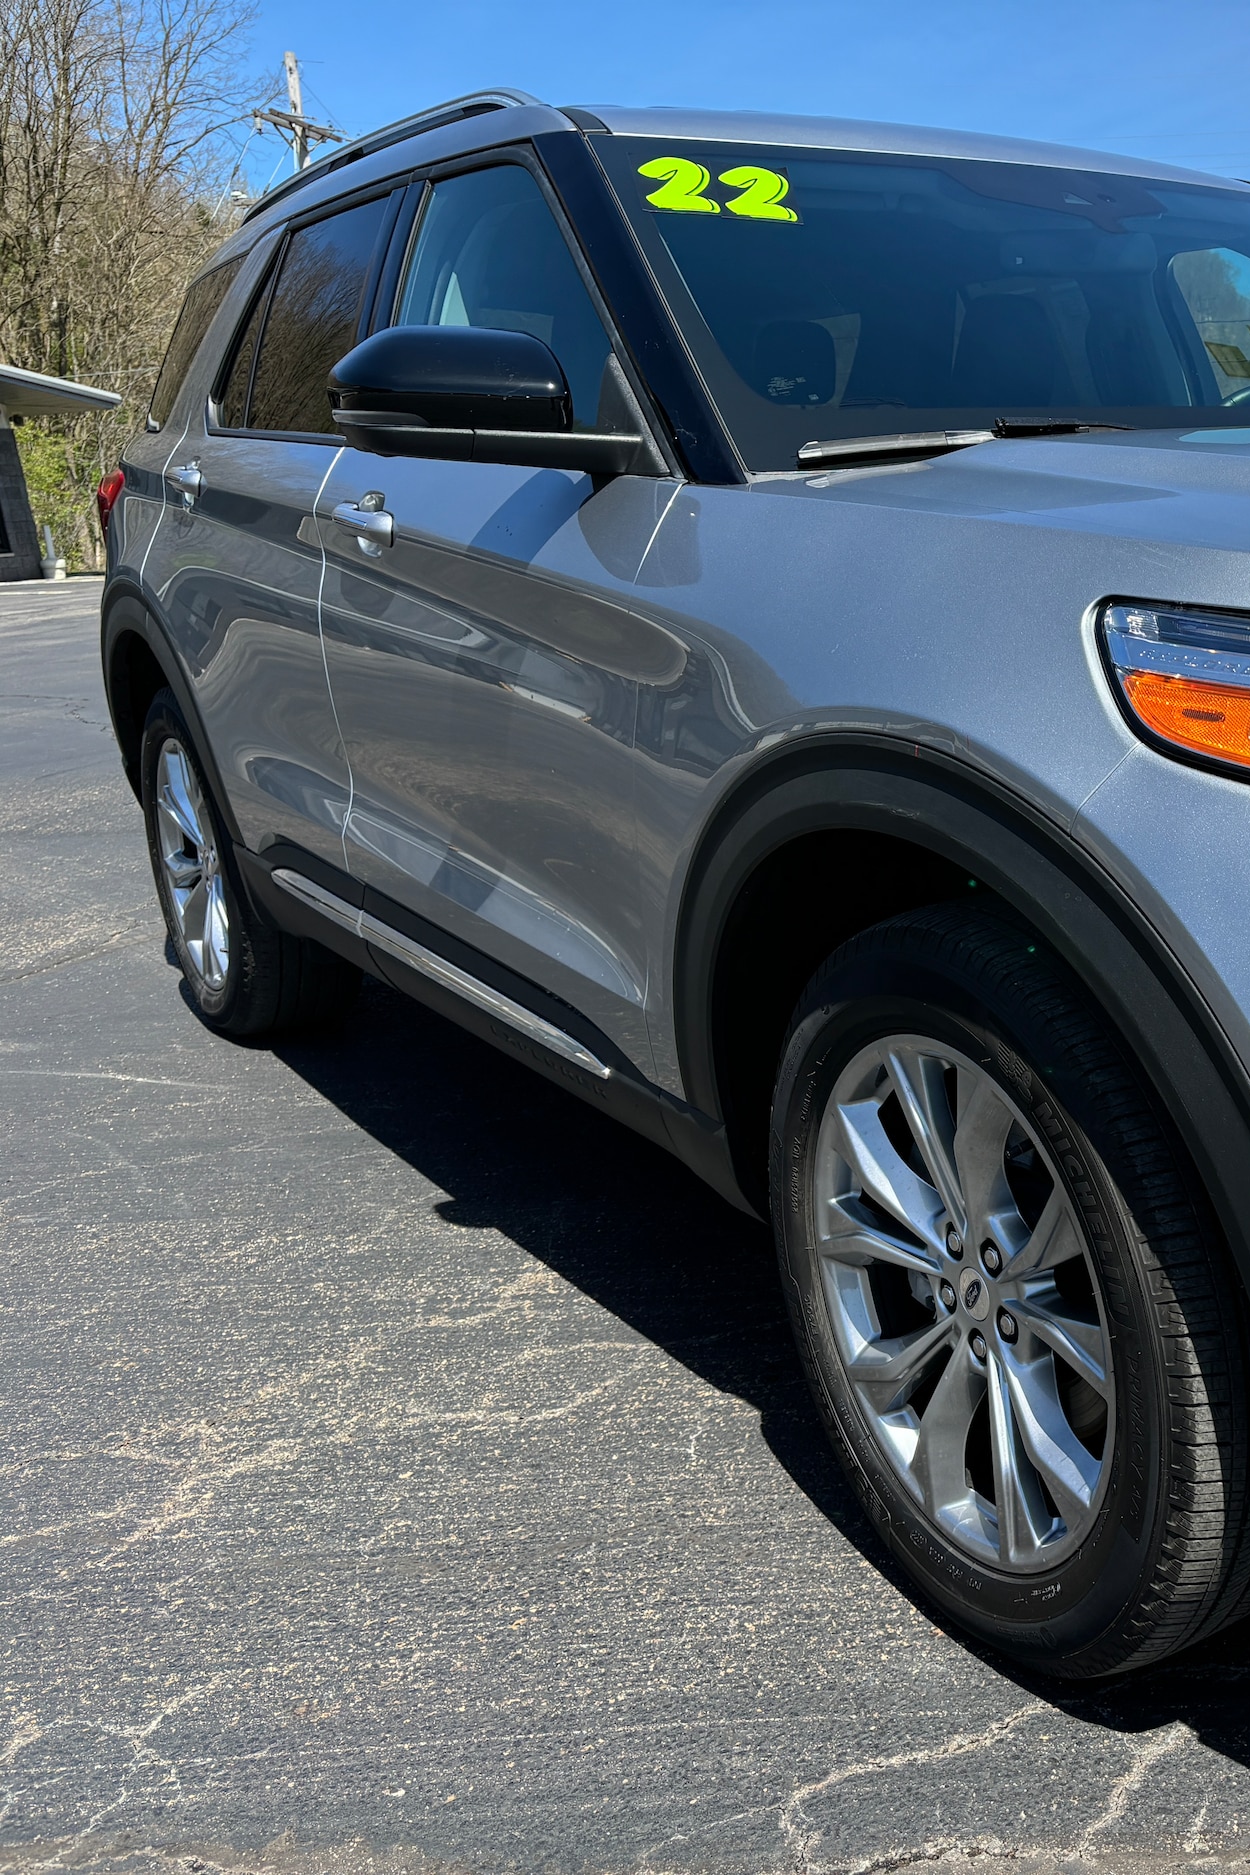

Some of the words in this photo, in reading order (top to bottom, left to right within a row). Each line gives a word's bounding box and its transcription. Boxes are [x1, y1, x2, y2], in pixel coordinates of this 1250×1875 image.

[637, 156, 798, 222] 22
[1033, 1102, 1129, 1317] MICHELIN
[1126, 1354, 1145, 1481] PRIMACY
